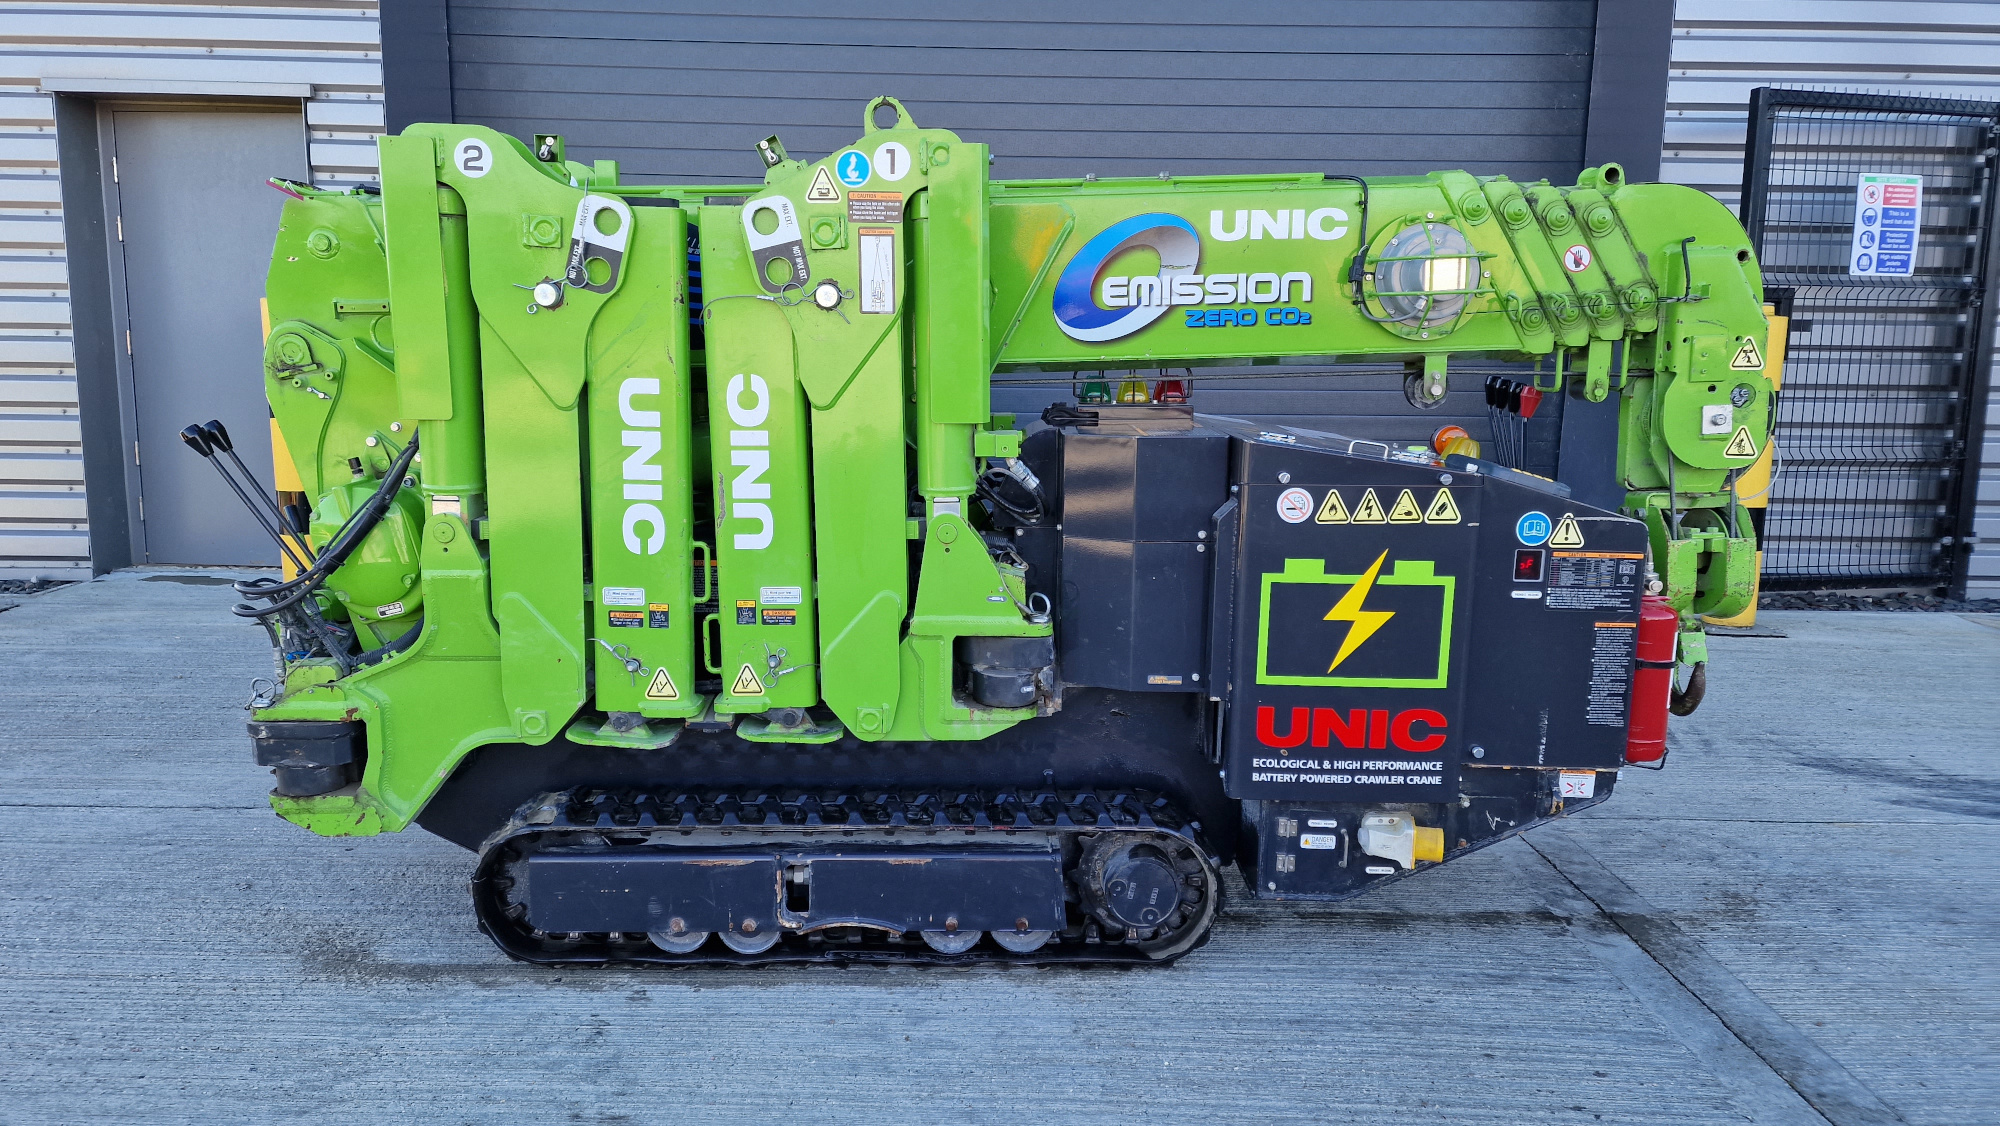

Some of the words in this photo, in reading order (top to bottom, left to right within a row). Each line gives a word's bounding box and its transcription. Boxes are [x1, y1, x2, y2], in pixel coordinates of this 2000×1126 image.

[463, 145, 484, 172] 2
[885, 148, 896, 175] 1
[781, 203, 791, 216] MAX
[784, 215, 793, 228] EXT.
[1210, 207, 1349, 241] UNIC
[792, 245, 802, 257] NOT
[795, 257, 805, 270] MAX
[568, 267, 578, 279] NOT
[798, 269, 808, 282] EXT.
[1102, 271, 1312, 307] EMISSION
[1185, 308, 1257, 328] ZERO
[618, 377, 666, 556] UNIC
[726, 373, 774, 550] UNIC
[1256, 706, 1448, 752] UNIC
[1252, 758, 1321, 770] ECOLOGICAL
[1322, 760, 1331, 770] &
[1333, 760, 1361, 770] HIGH
[1362, 761, 1443, 771] PERFORMANCE
[1252, 772, 1298, 783] BATTERY
[1299, 774, 1352, 784] POWERED
[1354, 775, 1404, 785] CRAWLER
[1406, 776, 1442, 785] CRANE
